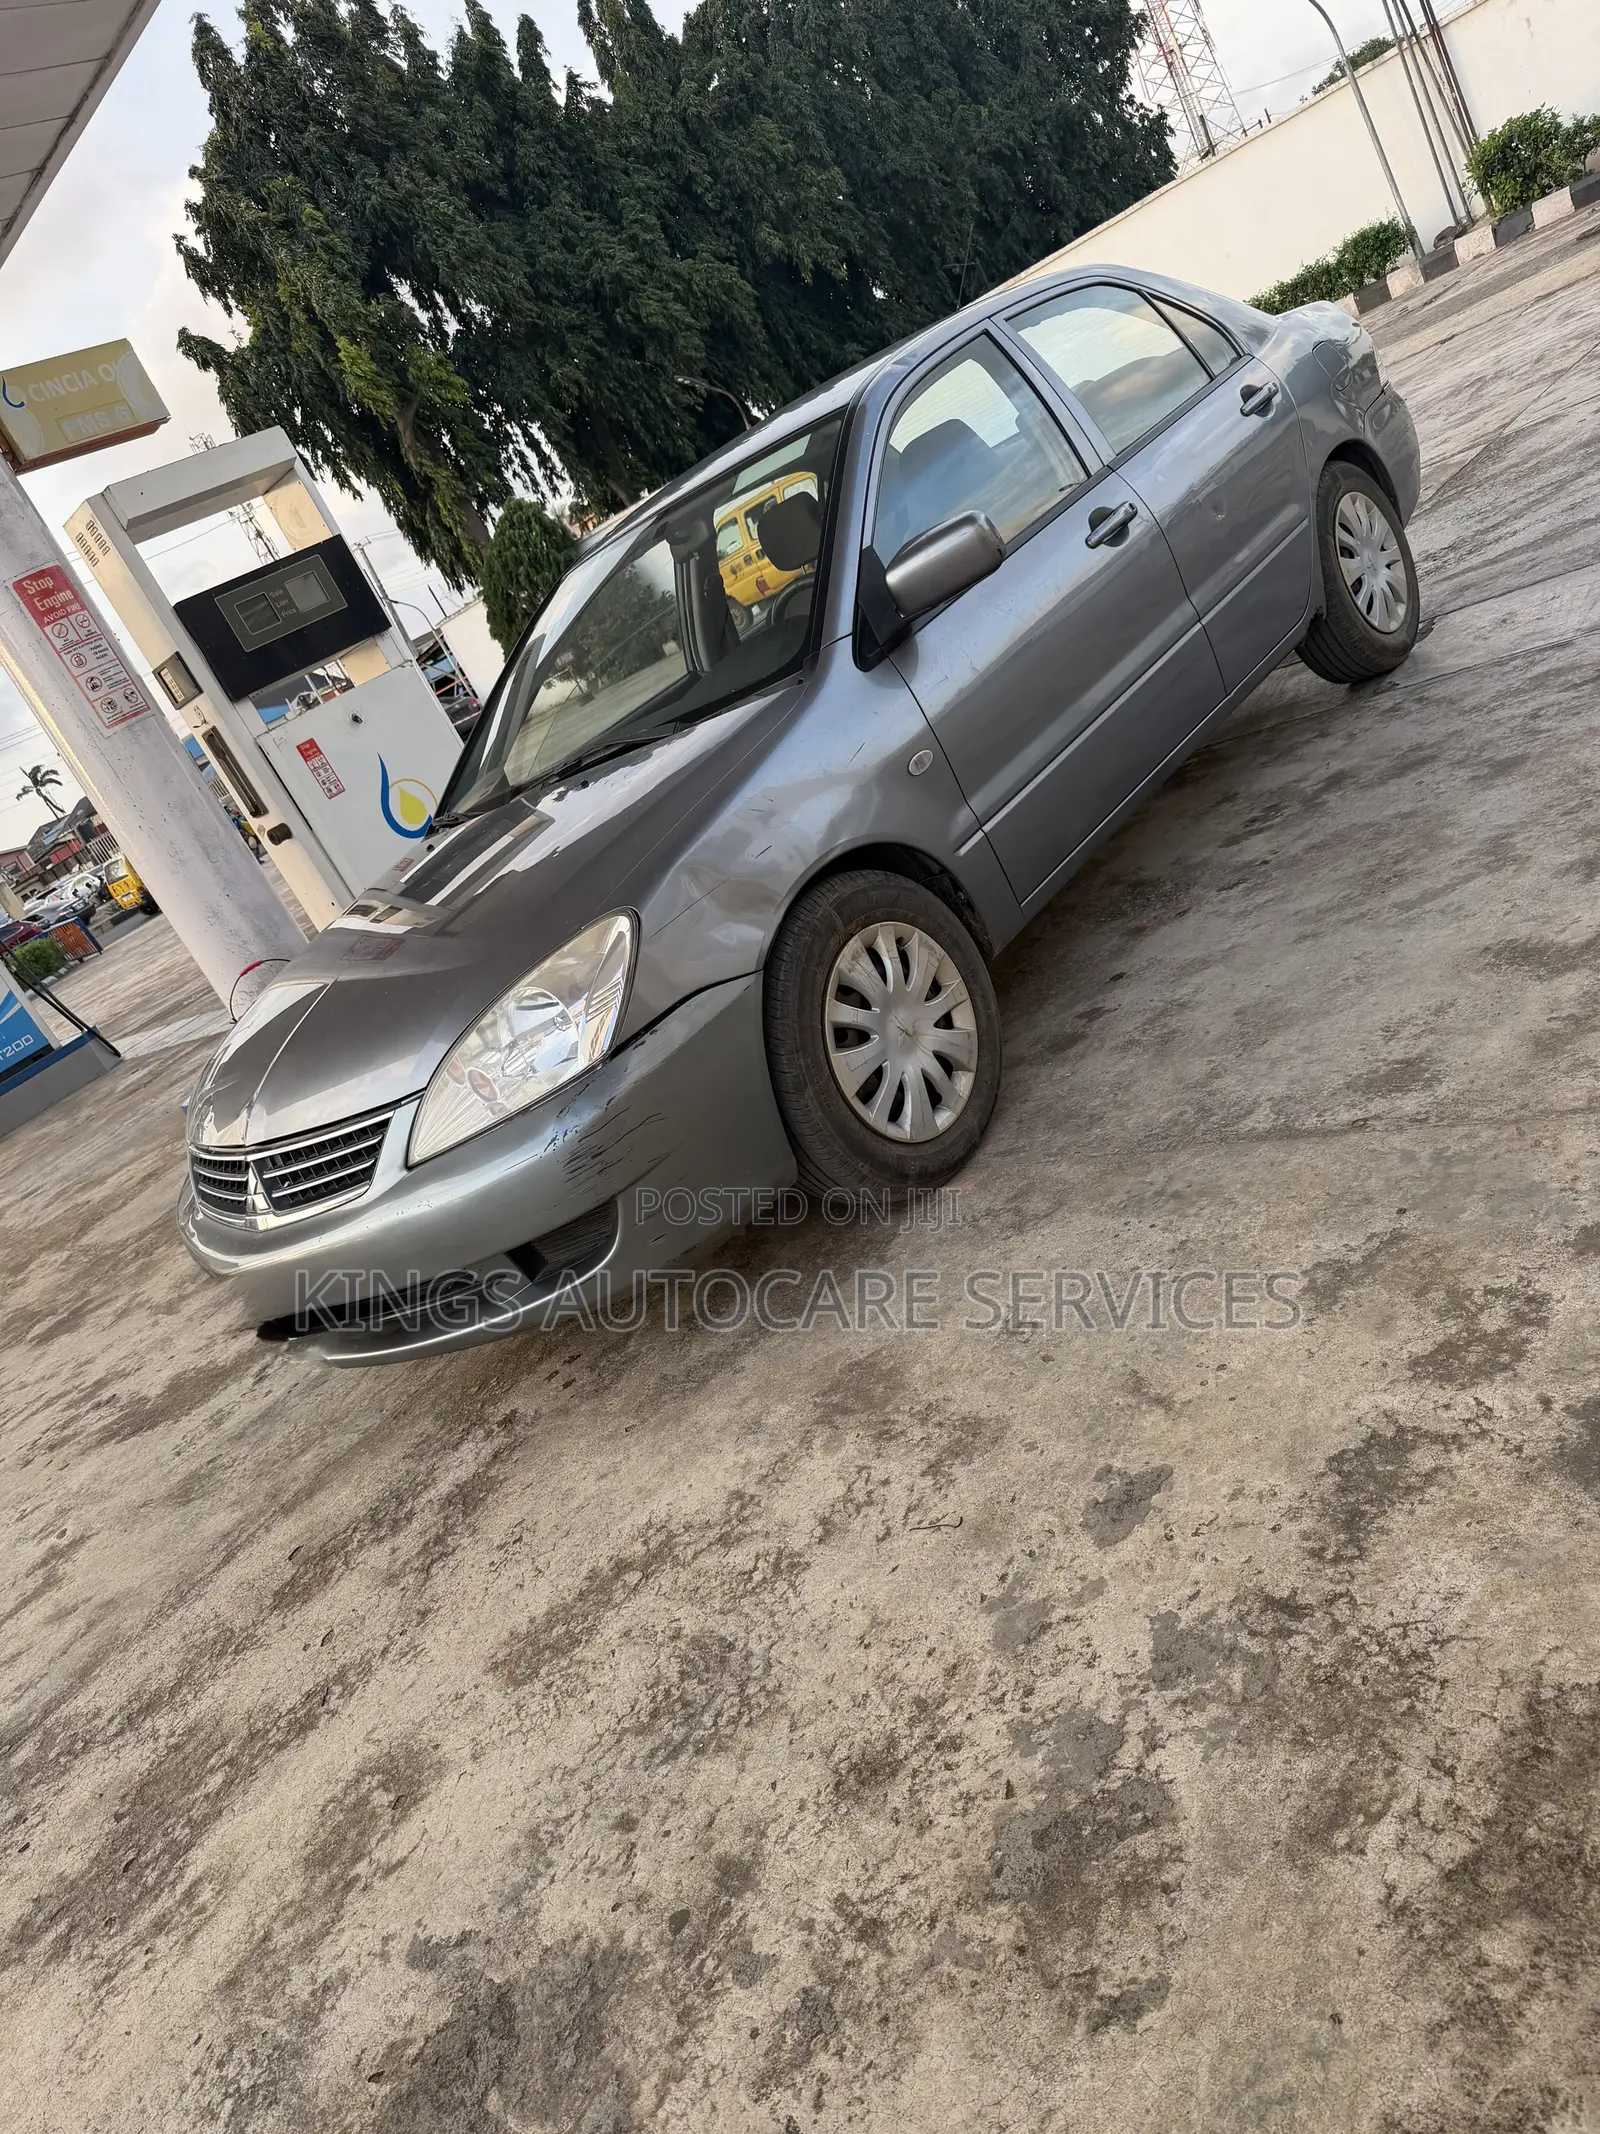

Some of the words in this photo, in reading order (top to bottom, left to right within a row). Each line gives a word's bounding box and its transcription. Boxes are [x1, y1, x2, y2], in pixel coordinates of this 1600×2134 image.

[28, 369, 98, 402] CINCIA
[22, 576, 54, 595] Stop
[269, 588, 284, 598] Sale
[34, 589, 75, 611] Engine
[44, 608, 67, 624] AVOID
[67, 603, 83, 615] FIRE
[281, 607, 297, 618] Price
